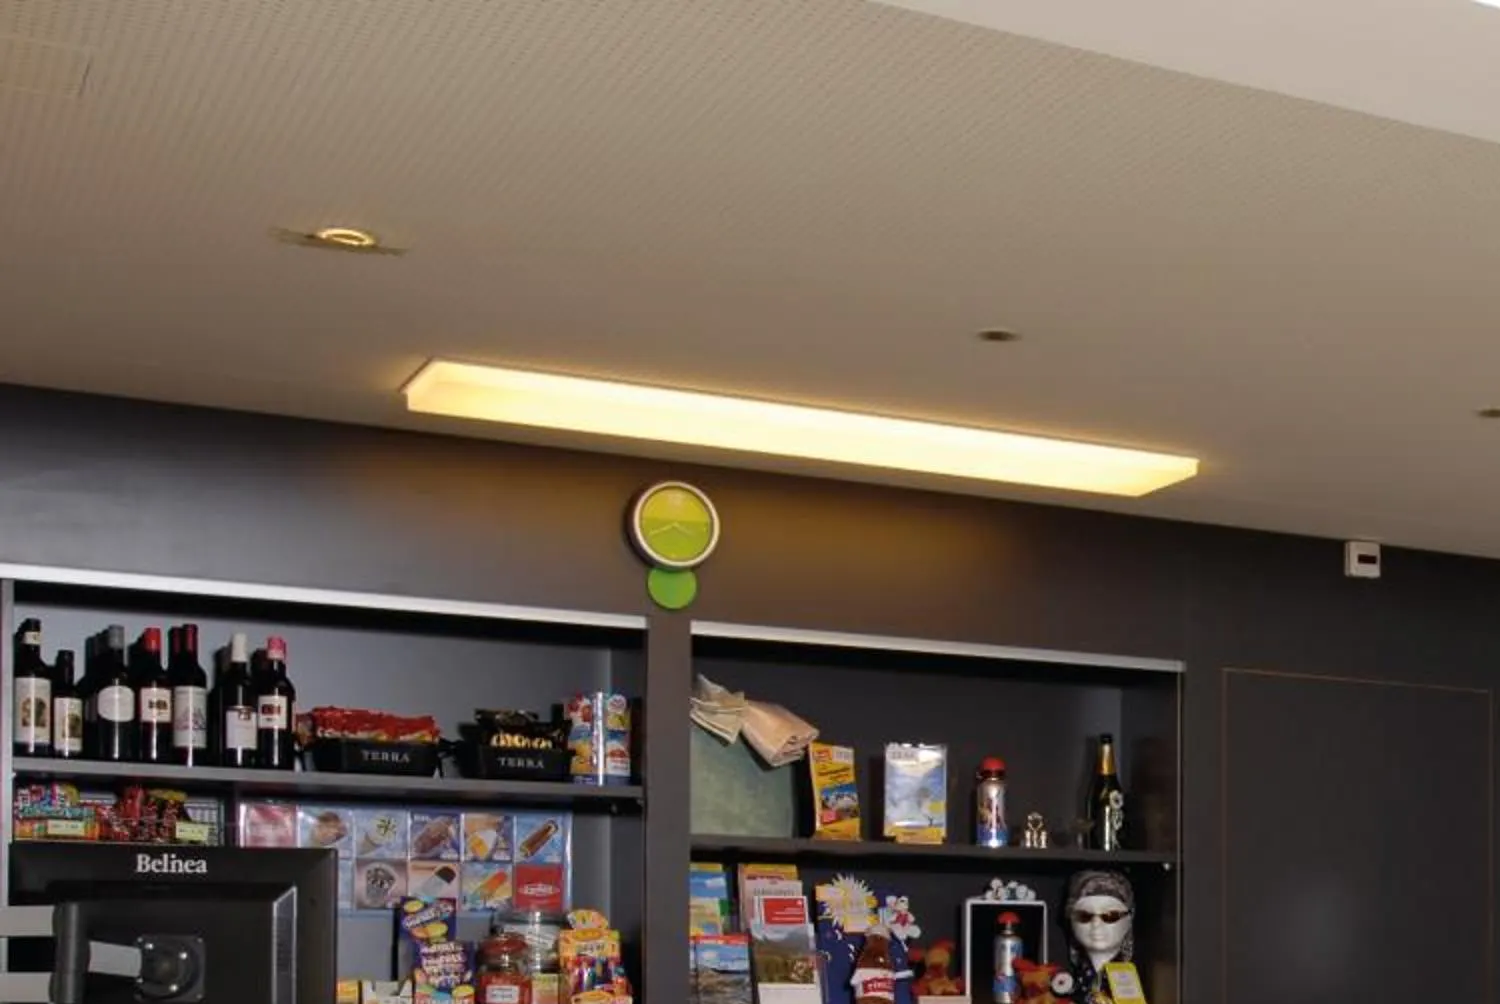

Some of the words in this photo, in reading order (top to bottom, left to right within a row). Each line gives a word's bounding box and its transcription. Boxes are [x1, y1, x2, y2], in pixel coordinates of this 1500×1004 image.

[361, 750, 410, 763] TERRA
[498, 757, 544, 769] TERRA
[136, 853, 208, 873] Belinea
